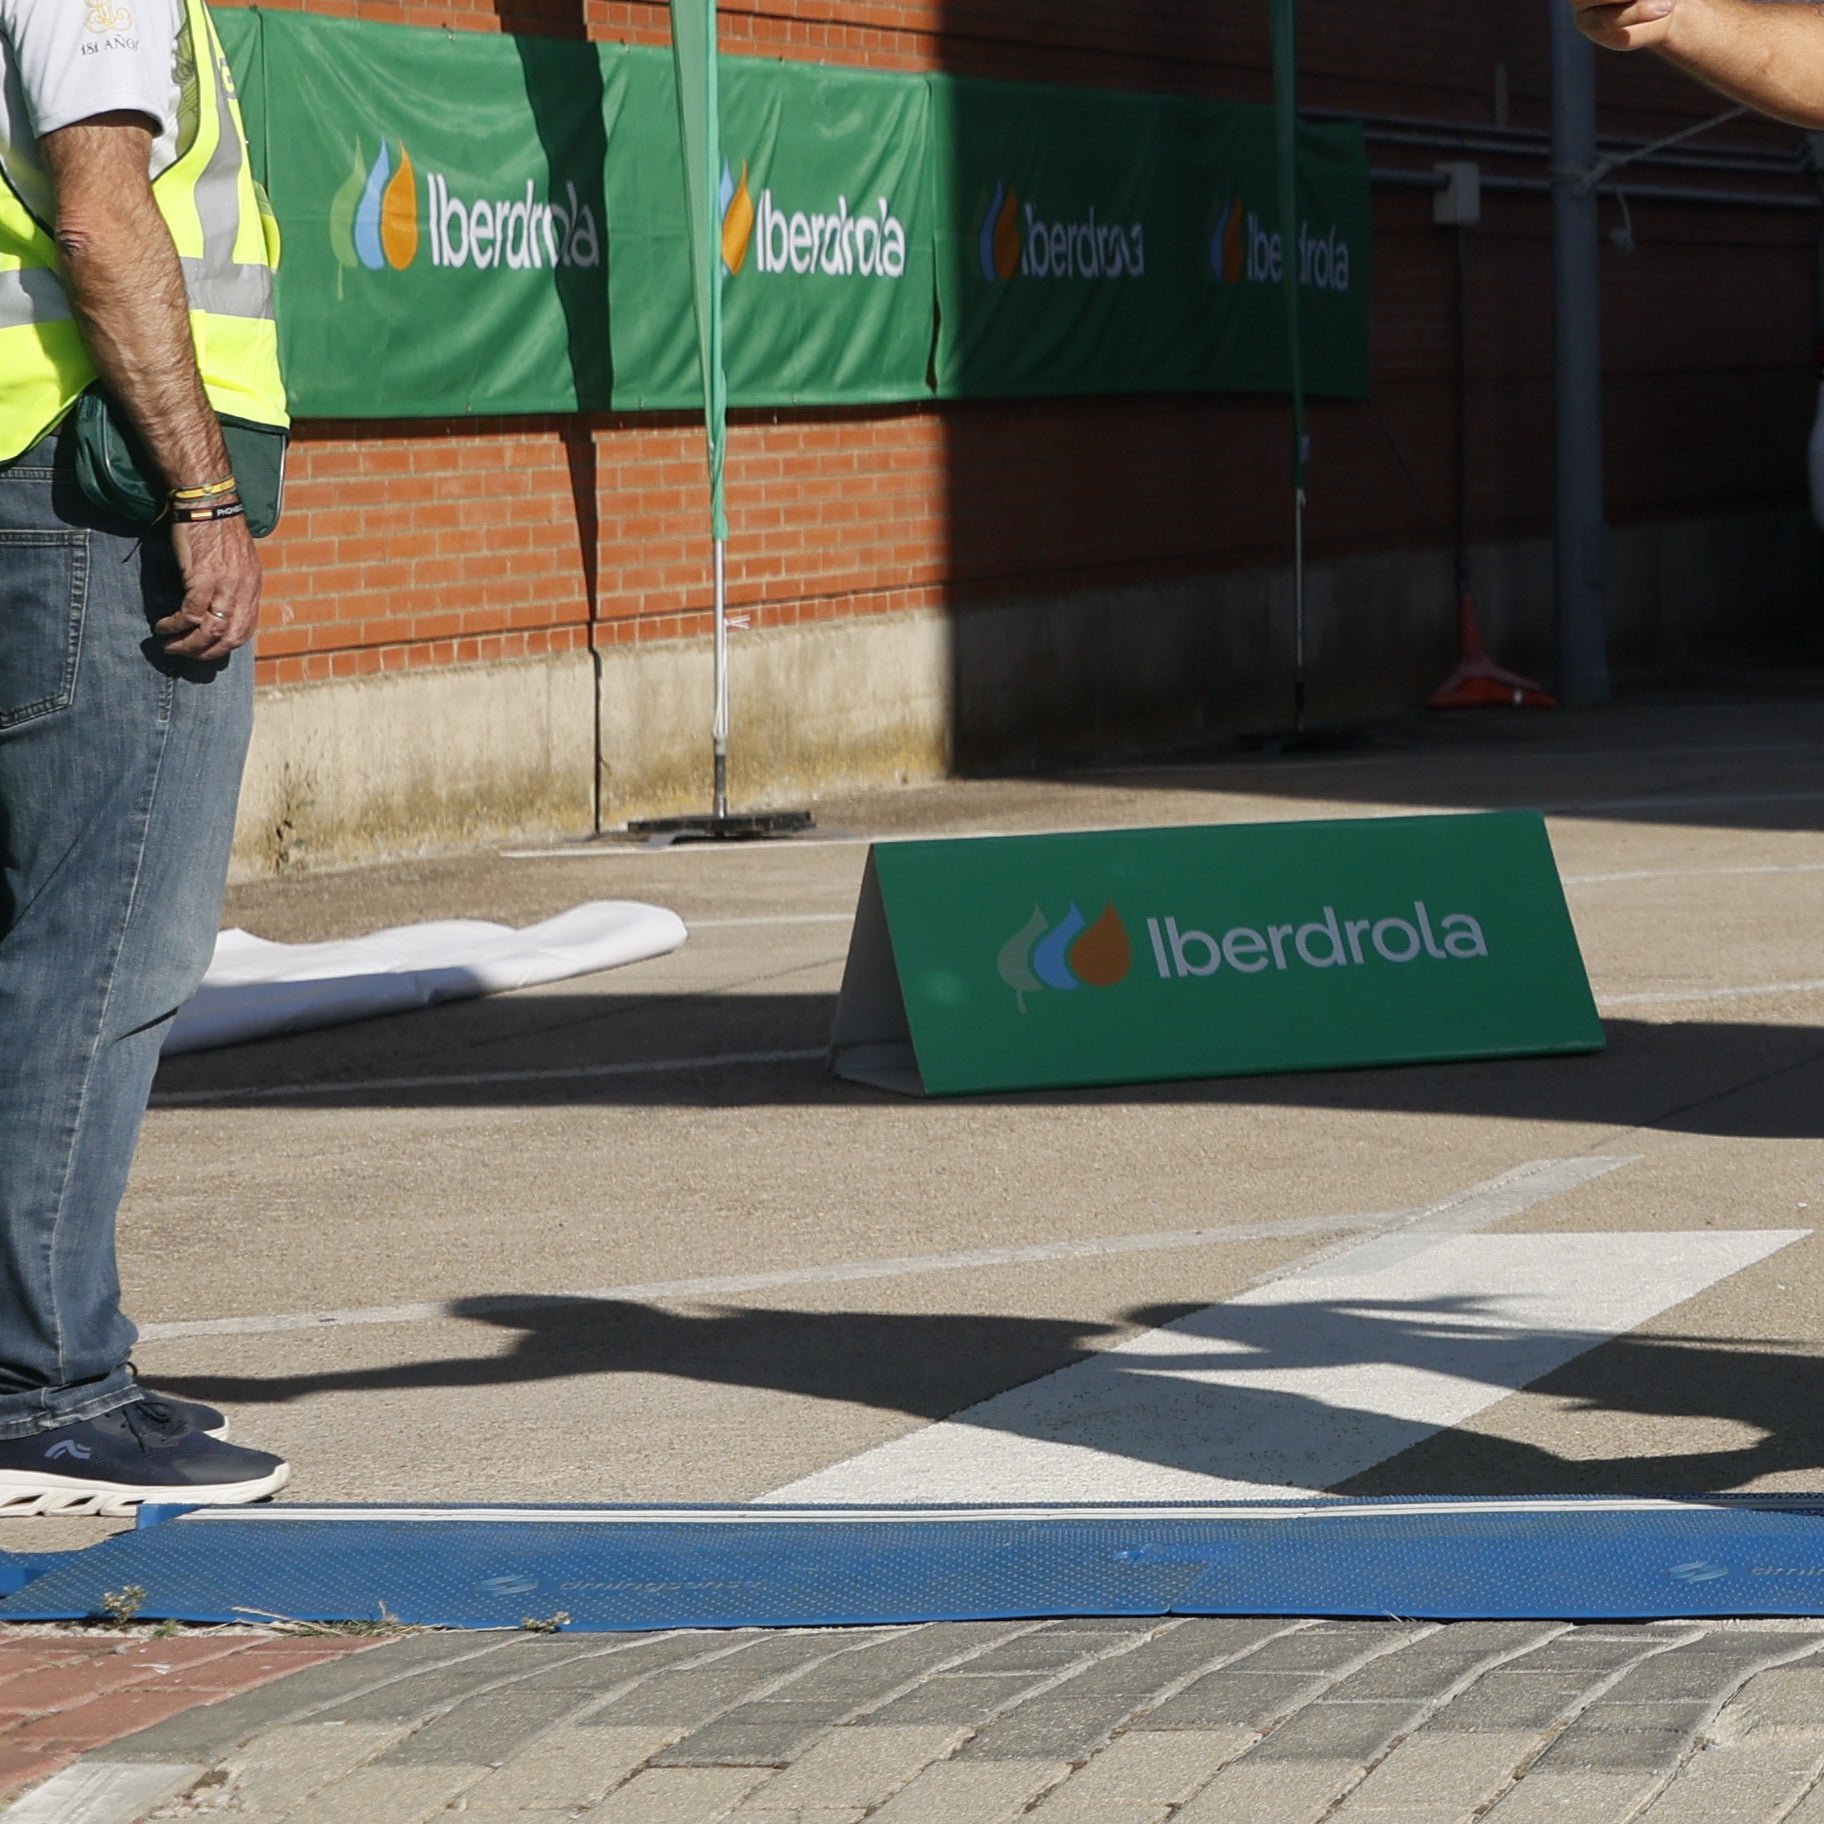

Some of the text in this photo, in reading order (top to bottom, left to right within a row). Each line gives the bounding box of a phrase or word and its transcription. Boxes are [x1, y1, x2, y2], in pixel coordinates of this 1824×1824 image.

[81, 42, 99, 56] 181
[427, 172, 600, 270] Iberdrola
[756, 187, 906, 279] Iberdrola
[1021, 201, 1145, 279] Iberdroa
[1247, 210, 1350, 292] Ibedrola
[1146, 899, 1490, 979] Iberdrola
